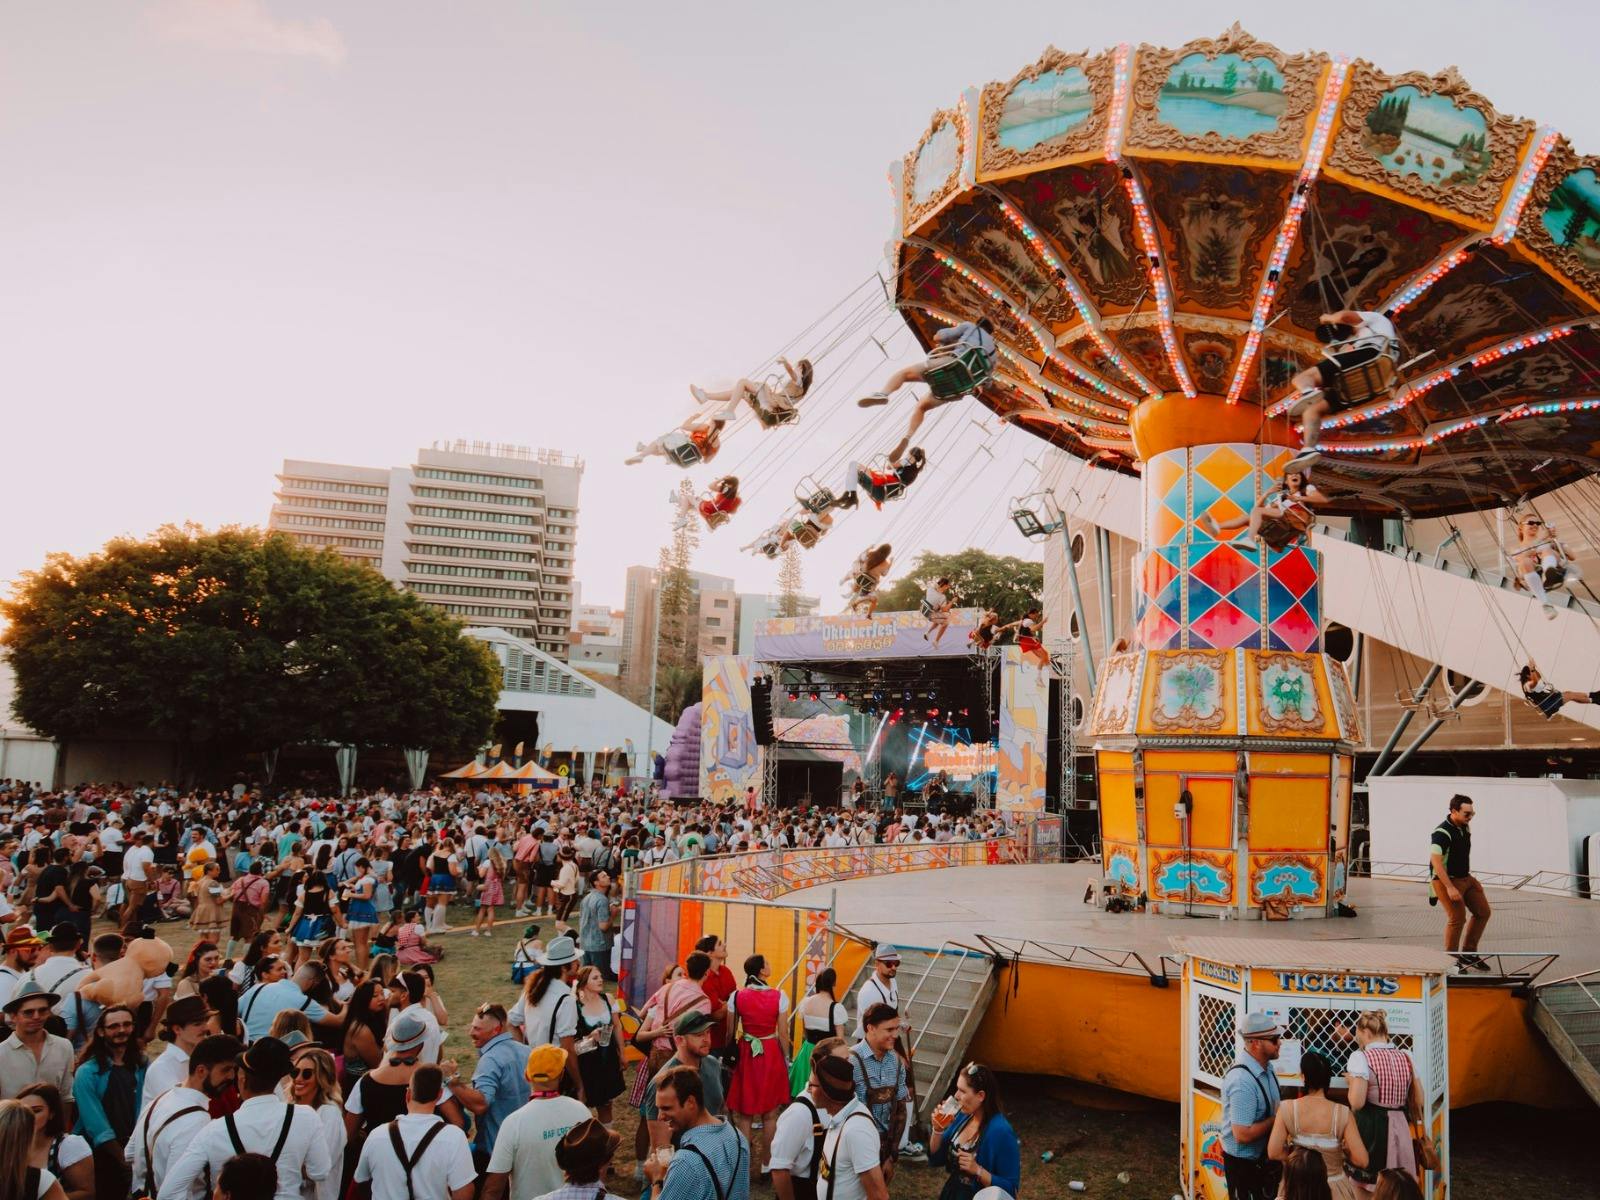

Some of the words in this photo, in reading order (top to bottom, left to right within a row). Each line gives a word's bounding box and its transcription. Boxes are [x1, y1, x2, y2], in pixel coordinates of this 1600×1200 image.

[823, 621, 897, 641] Oktoberfest
[1199, 960, 1239, 984] TICKETS
[1273, 971, 1400, 995] TICKETS
